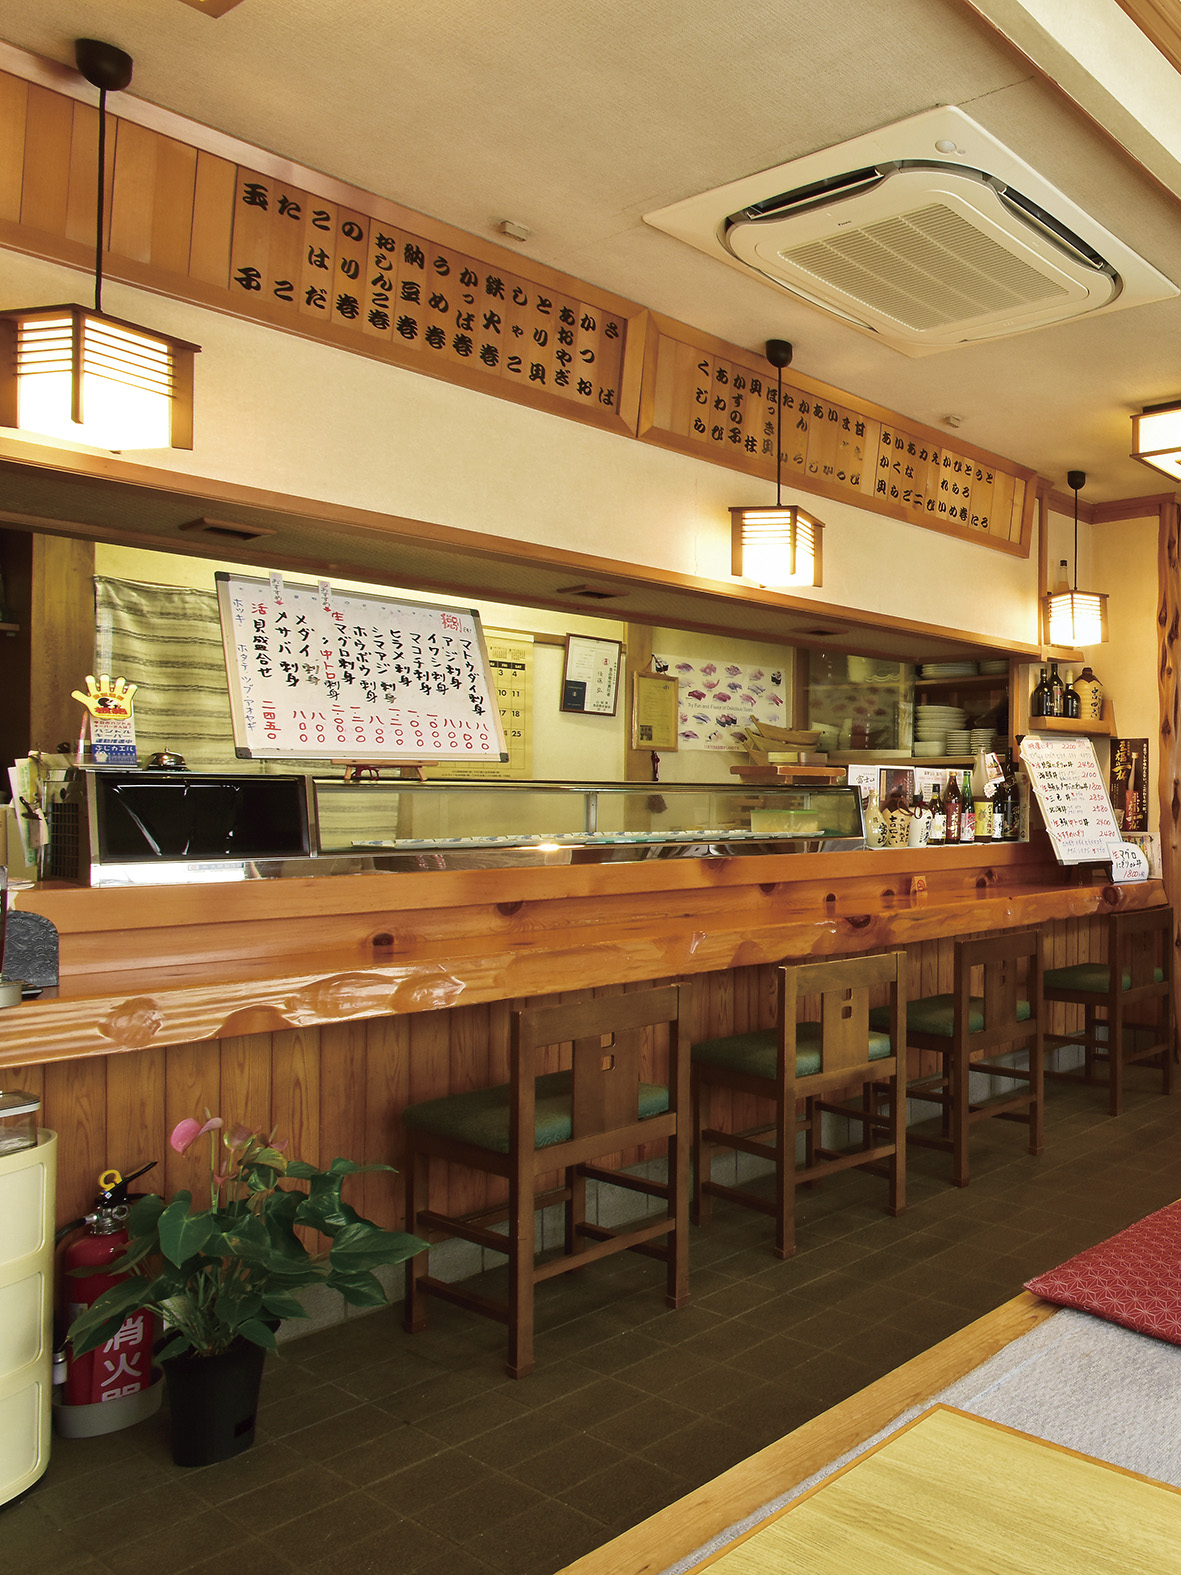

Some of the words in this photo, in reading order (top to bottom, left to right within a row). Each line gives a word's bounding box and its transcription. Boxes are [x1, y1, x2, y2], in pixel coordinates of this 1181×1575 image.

[234, 183, 269, 291] 玉子
[273, 195, 302, 302] たこ
[305, 210, 331, 310] こはだ
[336, 221, 364, 320] のり巻
[367, 232, 396, 330] おしんこ巻
[396, 243, 425, 340] 納豆巻
[425, 255, 450, 350] うめ巻
[480, 274, 505, 367] 鉄火巻
[506, 286, 528, 374] しゃこ
[529, 295, 553, 385] とり貝
[554, 306, 576, 387] あおやぎ
[576, 313, 597, 396] かつお
[598, 321, 619, 407] さば
[693, 359, 710, 434] くじら
[711, 366, 729, 441] あわび
[727, 374, 746, 444] かずの子
[744, 378, 762, 454] 貝柱
[761, 386, 778, 457] ほっき貝
[823, 408, 838, 475] いか
[836, 416, 851, 480] まろ
[876, 430, 892, 496] あか貝
[890, 436, 904, 499] いくら
[902, 441, 917, 502] あなご
[926, 451, 940, 512] えび
[938, 455, 952, 513] かれい
[948, 460, 962, 518] ひらめ
[959, 463, 973, 522] とろ巻
[970, 468, 983, 527] うに
[980, 471, 994, 529] とろ
[251, 602, 273, 679] 活貝盛合せ
[389, 629, 412, 687] ヒラメ刺身
[427, 633, 449, 695] イワシ刺身
